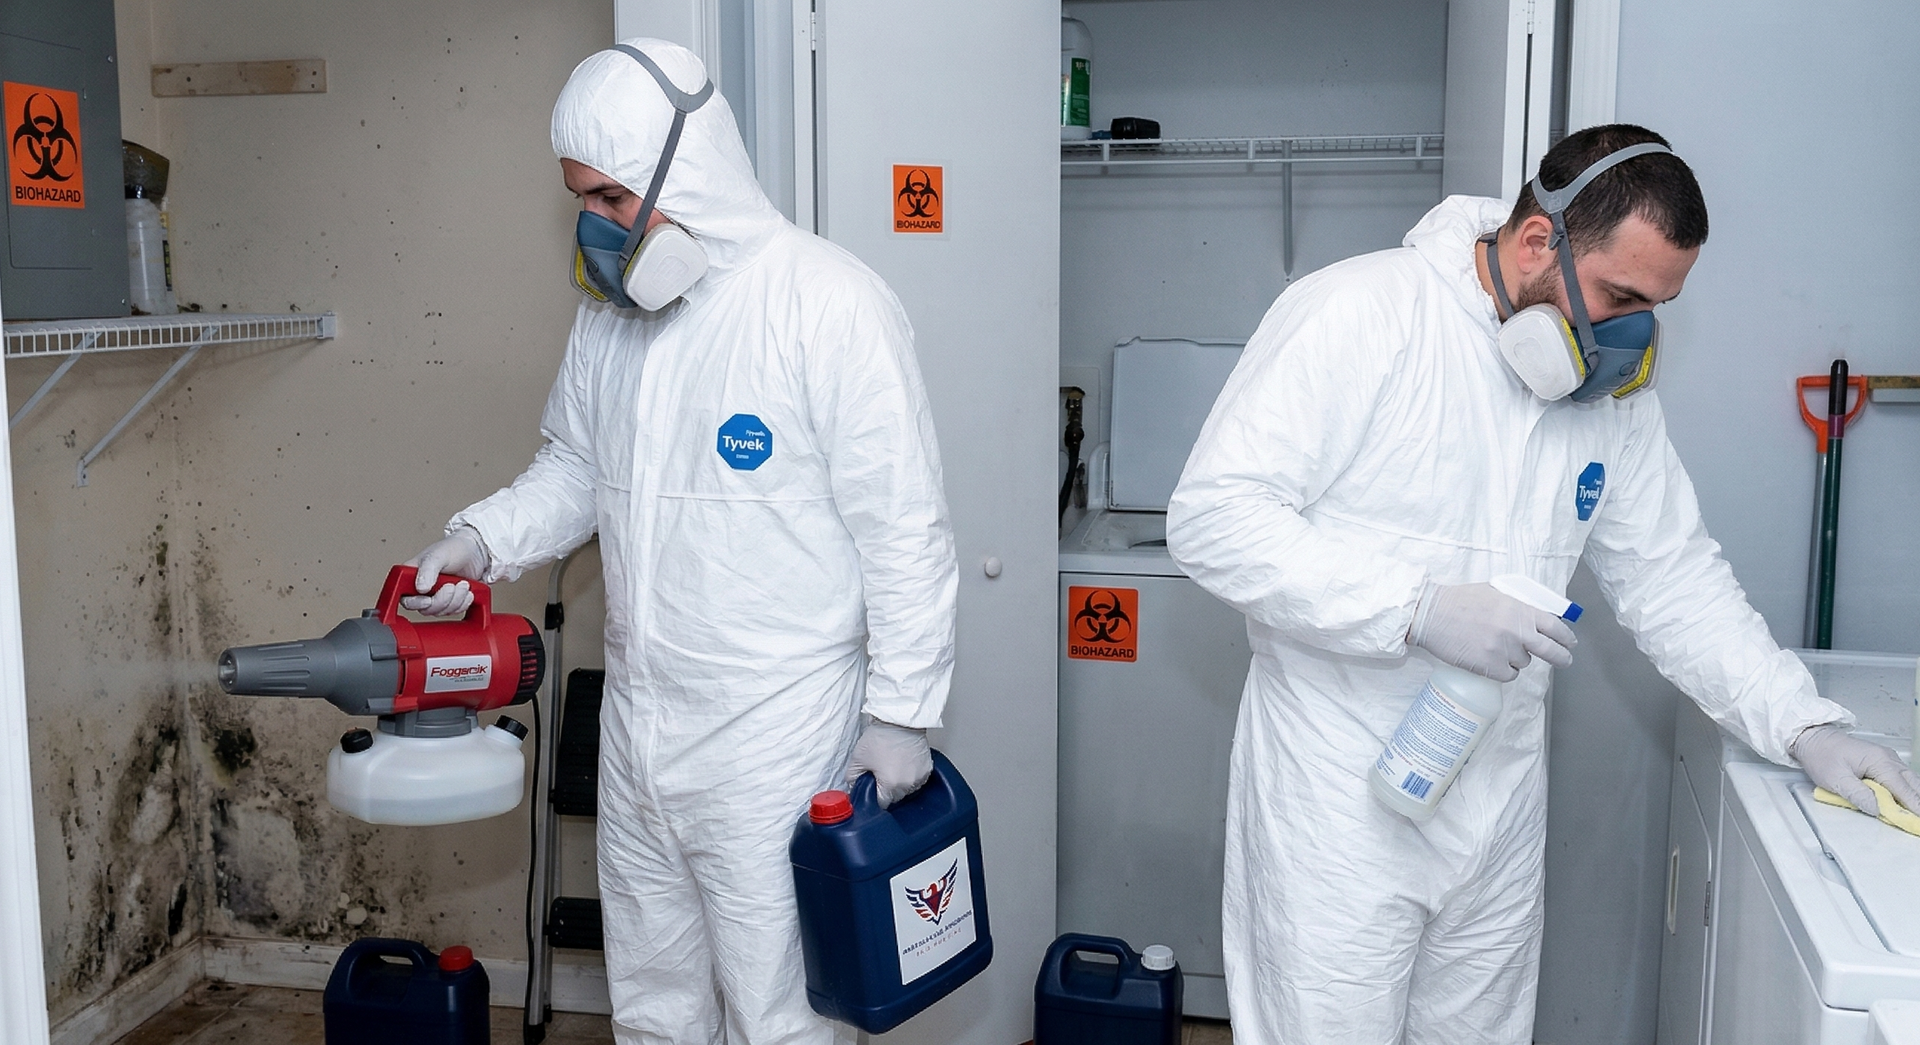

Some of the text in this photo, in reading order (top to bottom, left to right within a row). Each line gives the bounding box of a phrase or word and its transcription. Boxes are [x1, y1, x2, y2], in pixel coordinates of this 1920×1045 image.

[15, 186, 81, 202] BIOHAZARD
[896, 220, 941, 229] BIOHAZARD
[722, 435, 765, 452] Tyvek
[1071, 645, 1134, 658] BIOHAZARD
